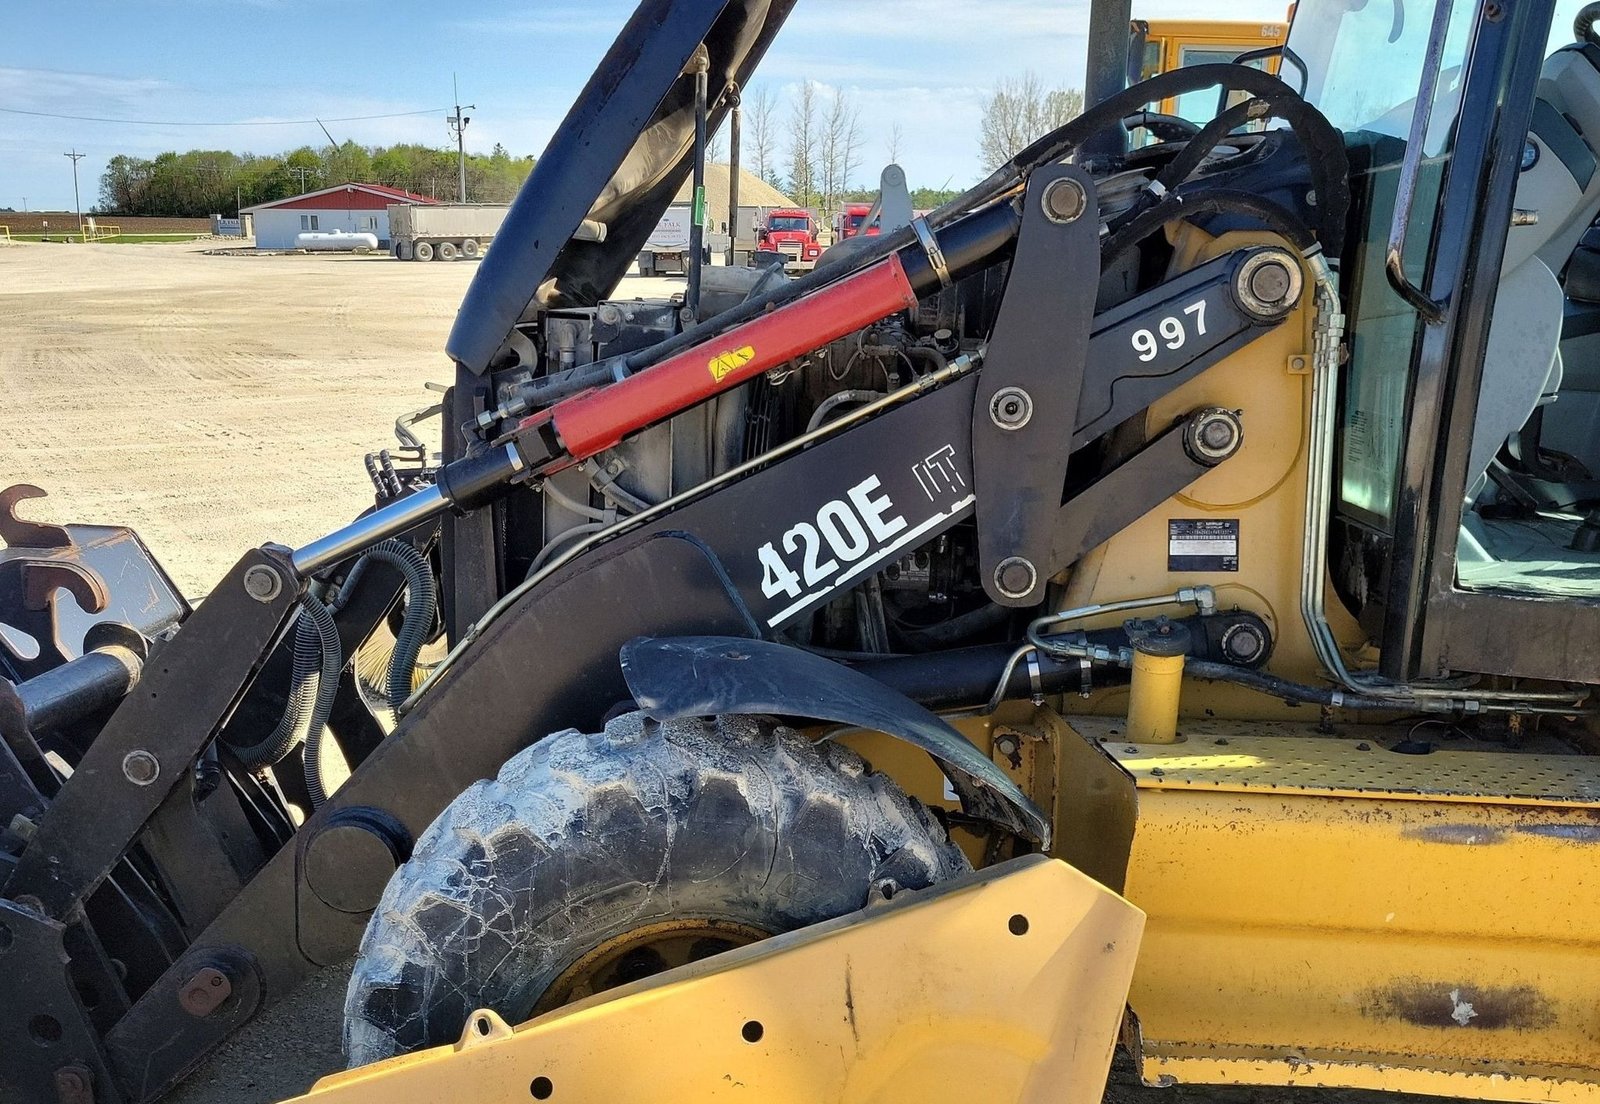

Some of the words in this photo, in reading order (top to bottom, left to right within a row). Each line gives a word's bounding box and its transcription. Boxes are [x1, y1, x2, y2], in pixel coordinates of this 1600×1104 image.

[1261, 24, 1281, 37] 645
[1131, 299, 1207, 362] 997
[757, 474, 908, 599] 420E
[911, 443, 965, 502] IT
